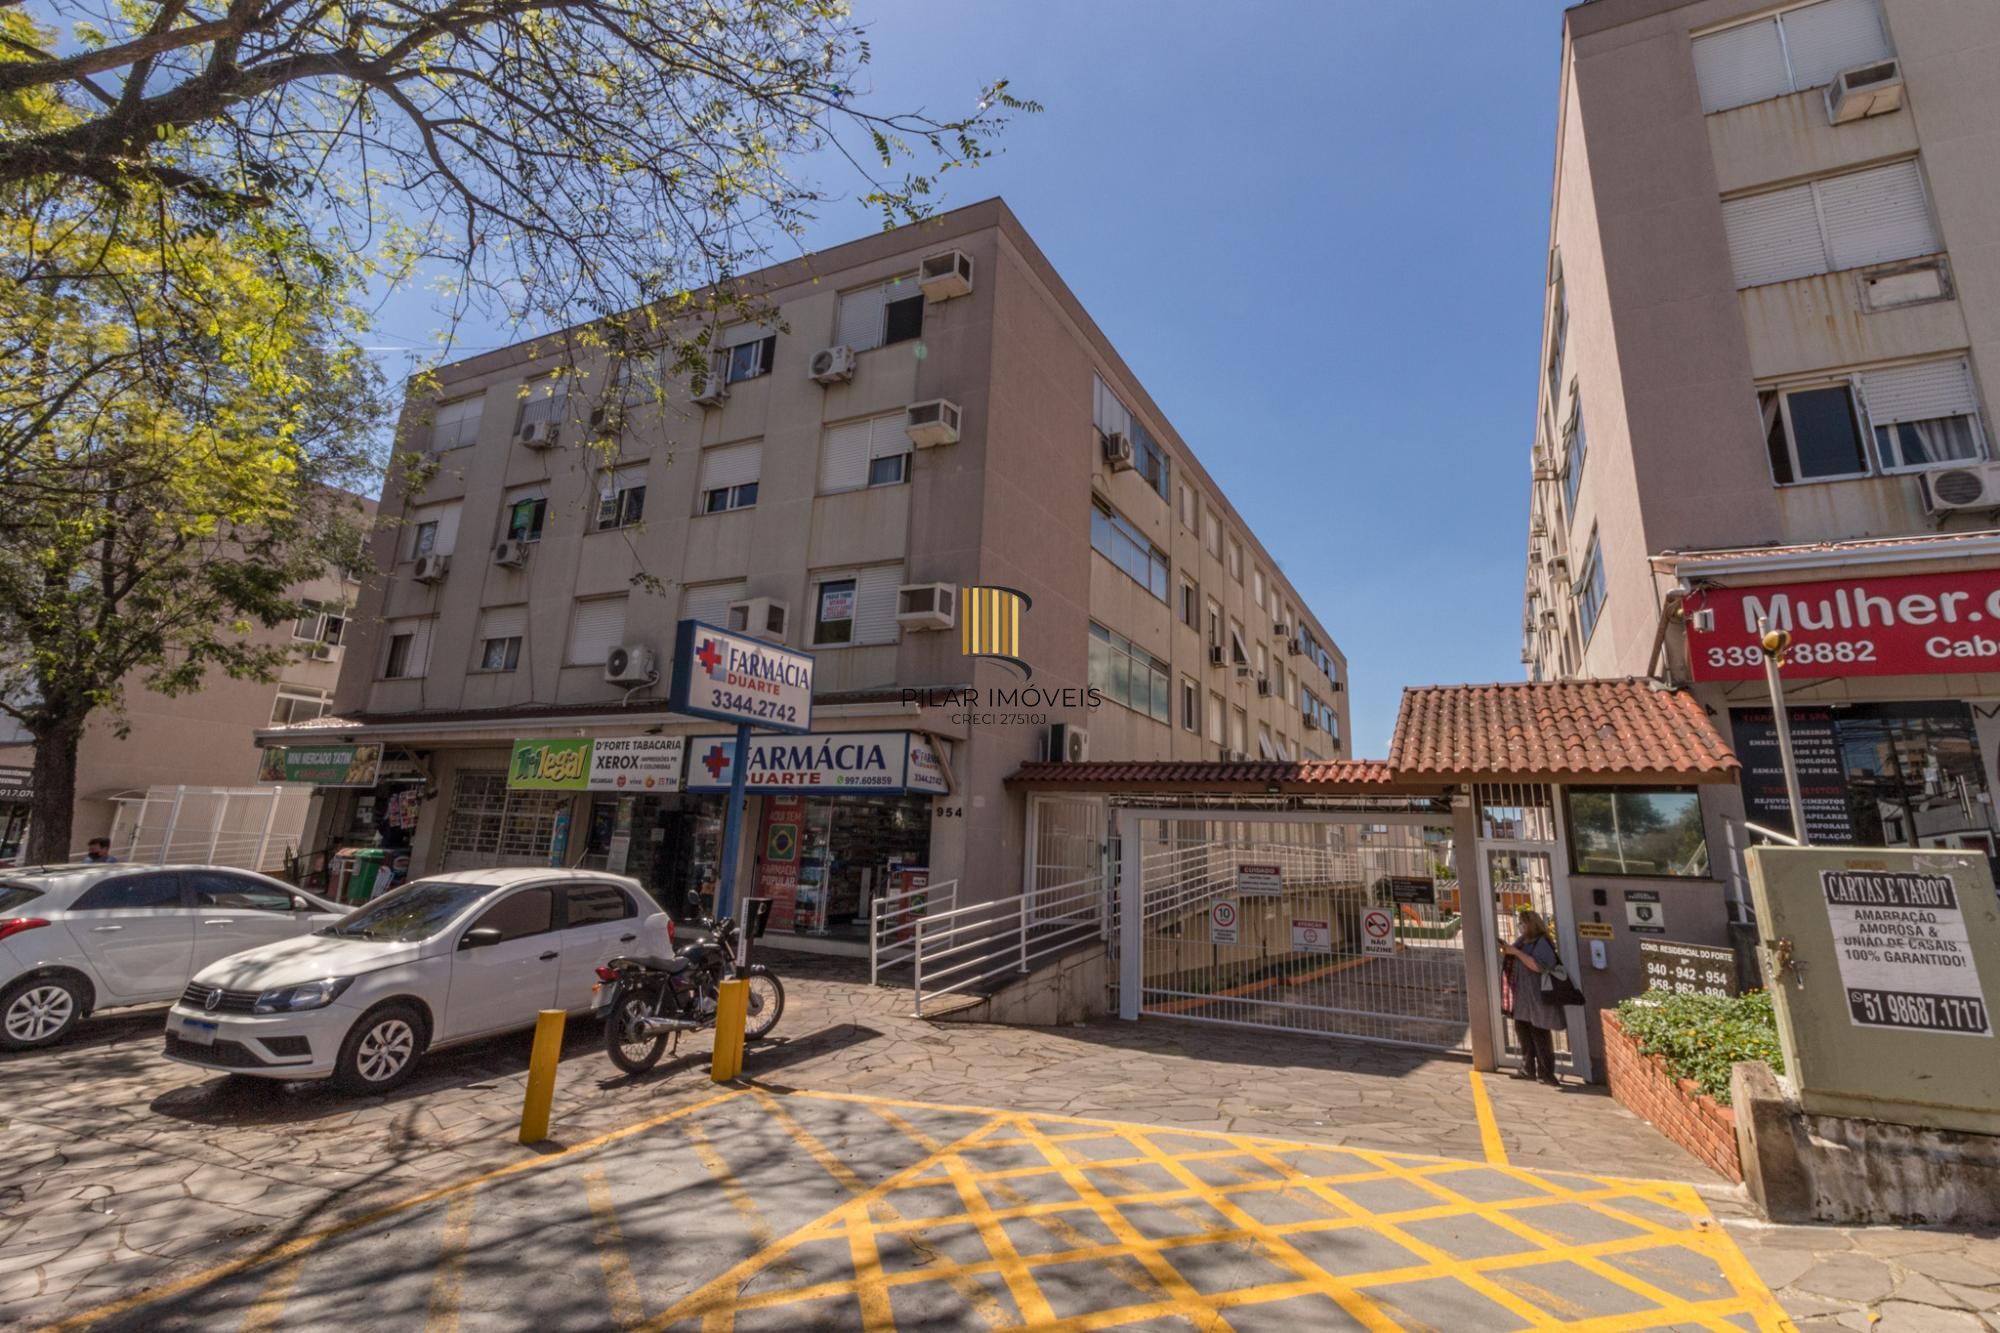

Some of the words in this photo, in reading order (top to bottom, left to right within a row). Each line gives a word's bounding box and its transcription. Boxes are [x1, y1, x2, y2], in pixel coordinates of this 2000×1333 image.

[1708, 640, 1877, 668] 339.8882
[1925, 635, 2000, 658] Cab
[729, 648, 809, 690] FARMÁCIA
[728, 673, 780, 696] DUARTE
[711, 689, 796, 722] 3344.2742
[633, 739, 681, 750] TABACARIA
[596, 755, 640, 769] XEROX
[746, 738, 886, 771] ARMÁCIA
[745, 772, 821, 785] UARTE
[844, 776, 892, 785] 997.605859
[937, 806, 962, 817] 954
[1828, 875, 1887, 904] CARTAS
[1884, 877, 1899, 903] E
[1899, 879, 1949, 905] TAROT
[1218, 908, 1230, 918] 10
[1854, 910, 1937, 925] AMARRAÇÃO
[1859, 924, 1925, 937] AMOROSA
[1928, 927, 1938, 938] &
[1371, 938, 1387, 946] NÃO
[1844, 937, 1883, 947] UNIÃO
[1886, 938, 1904, 949] DE
[1640, 942, 1659, 951] COND.
[1660, 946, 1699, 958] RESIDENCIAL
[1700, 950, 1710, 959] DO
[1711, 951, 1734, 962] FORTE
[1845, 949, 1881, 962] 100%
[1884, 952, 1967, 967] GARANTIDO!
[1647, 962, 1667, 975] 940
[1675, 966, 1696, 980] 942
[1705, 972, 1727, 985] 954
[1675, 981, 1695, 994] 962
[1705, 987, 1726, 998] 980
[1864, 993, 1885, 1022] 51
[1887, 994, 1984, 1030] 98687.1717
